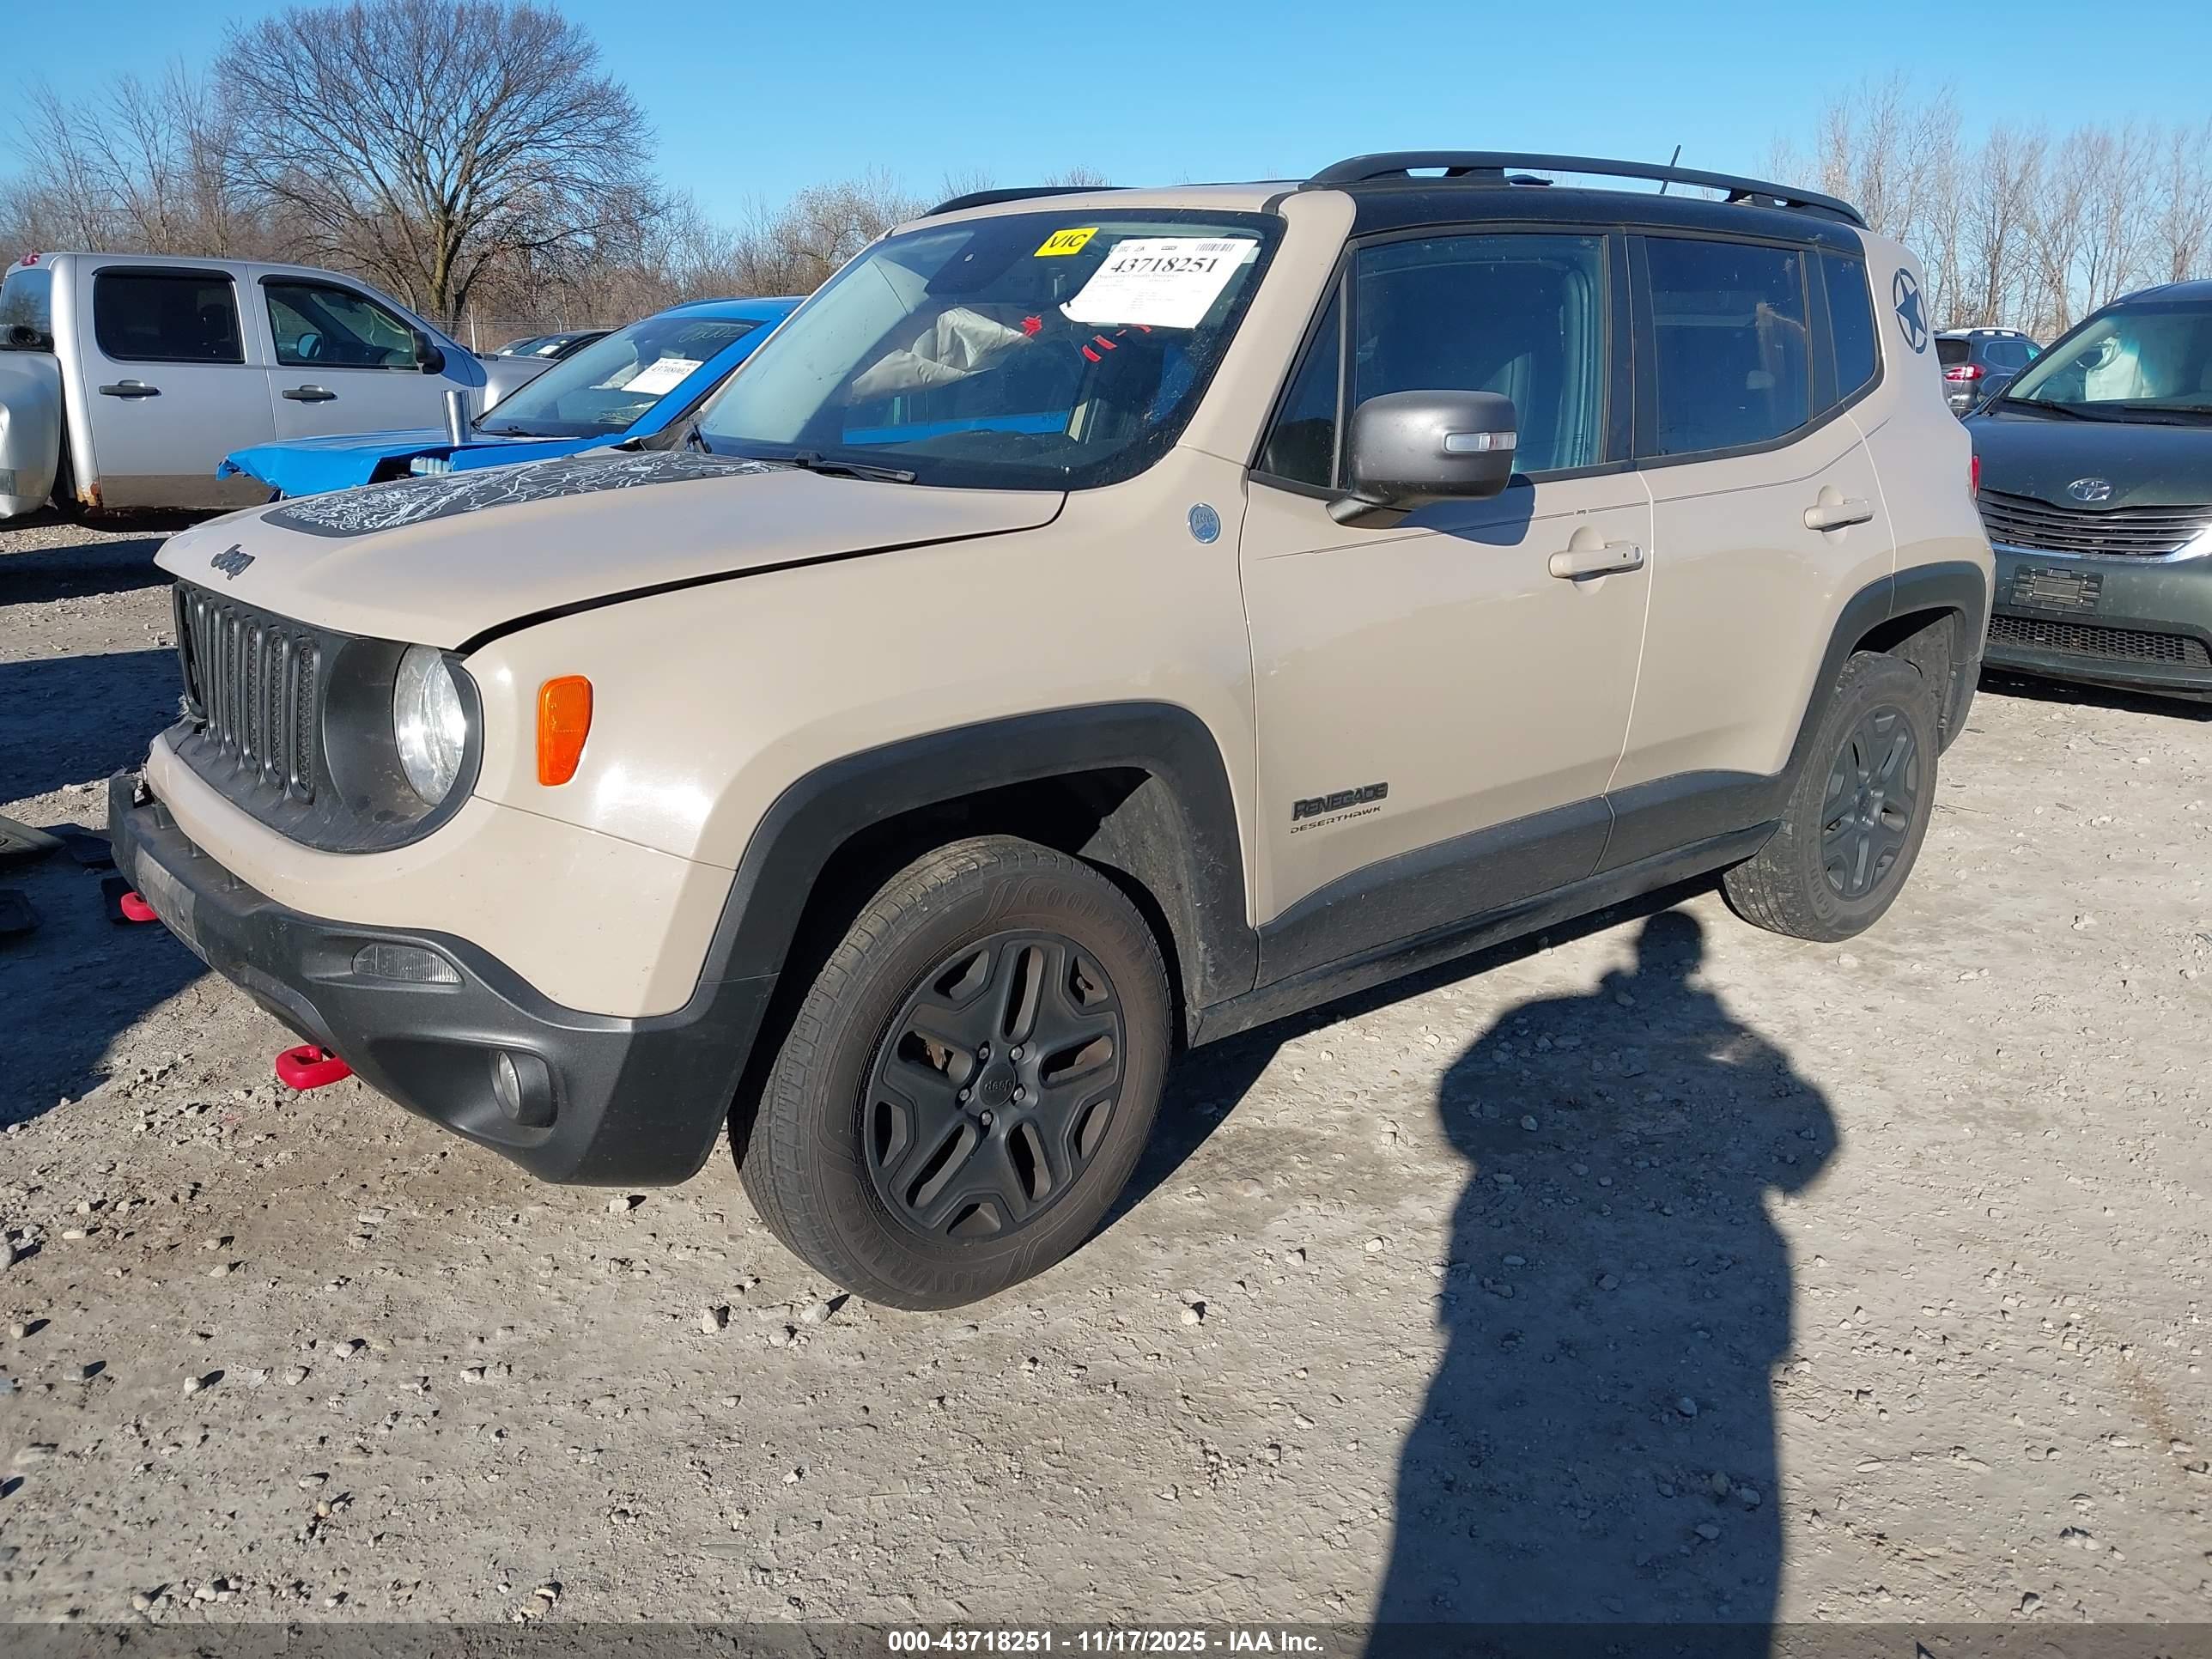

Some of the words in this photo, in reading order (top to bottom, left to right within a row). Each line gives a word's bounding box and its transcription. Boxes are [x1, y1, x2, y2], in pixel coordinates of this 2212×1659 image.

[1048, 234, 1089, 249] VIC
[1109, 257, 1220, 273] 43718251
[210, 544, 256, 580] Jeep
[1291, 781, 1389, 821] RENEGADE
